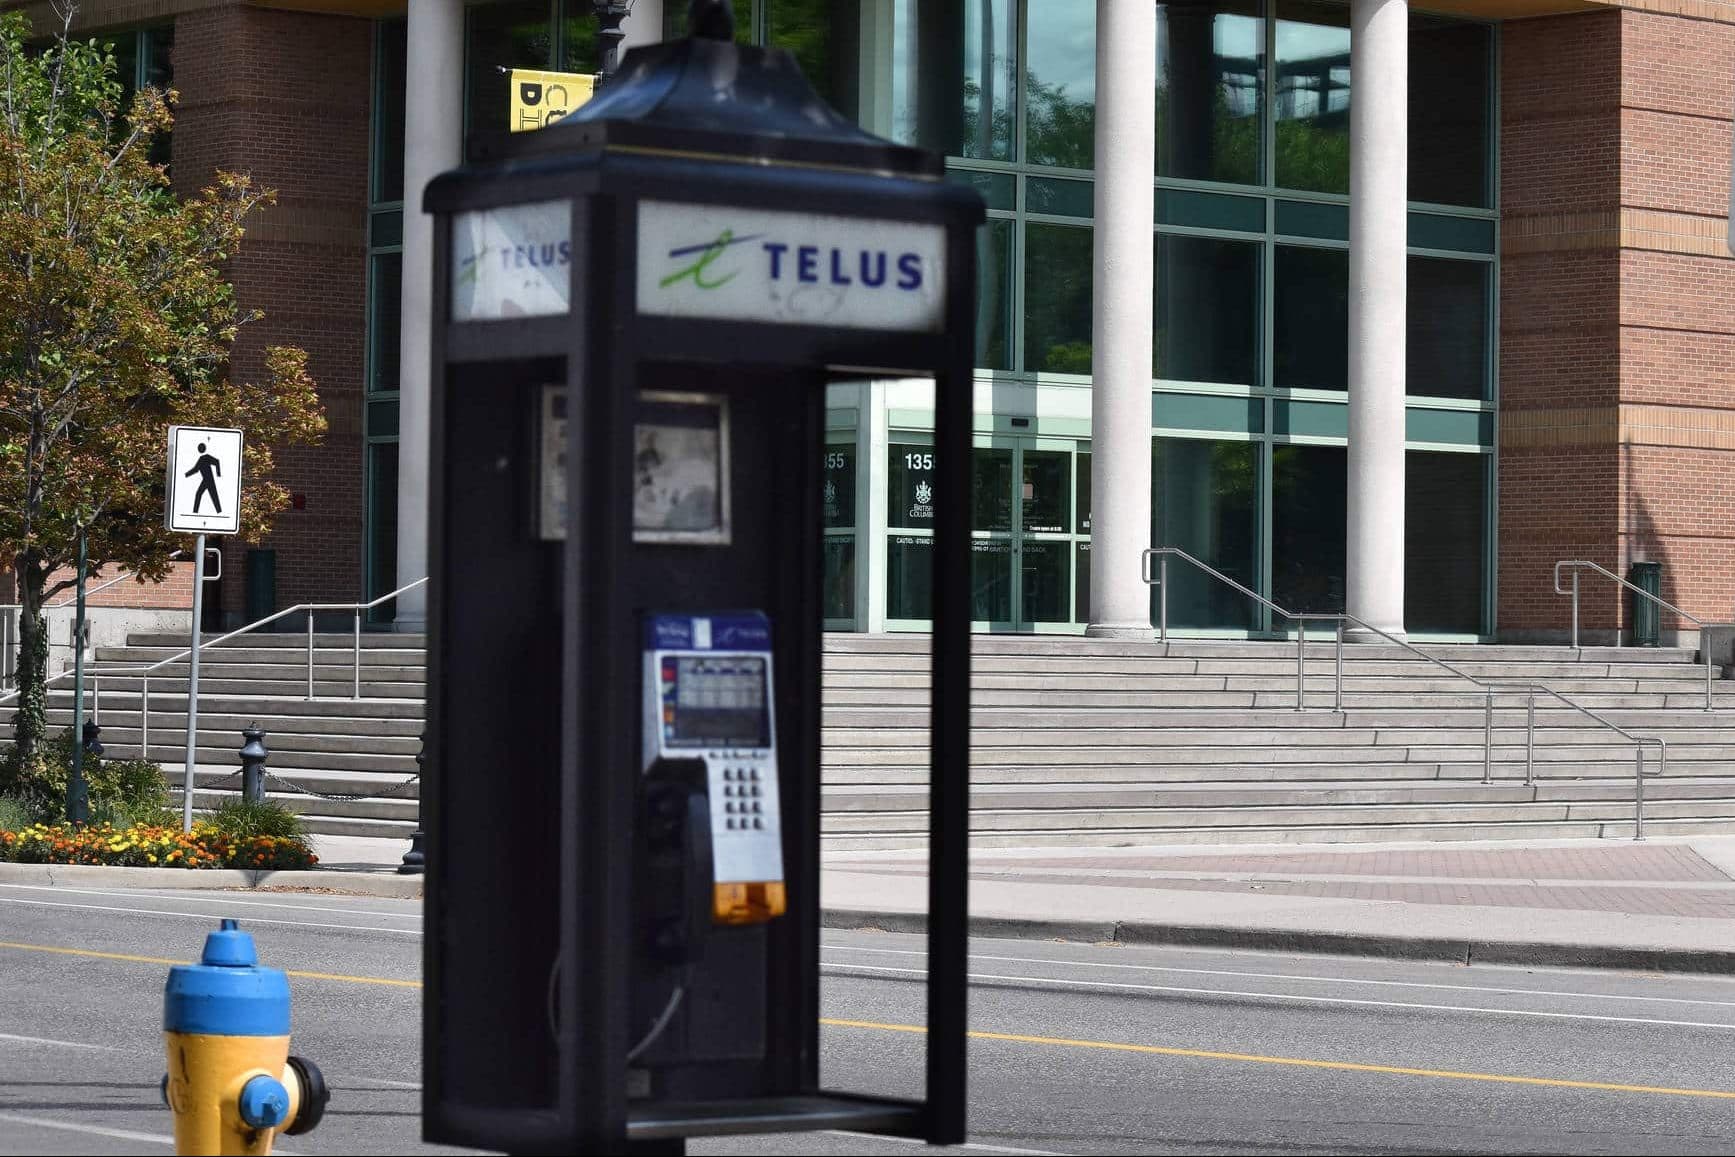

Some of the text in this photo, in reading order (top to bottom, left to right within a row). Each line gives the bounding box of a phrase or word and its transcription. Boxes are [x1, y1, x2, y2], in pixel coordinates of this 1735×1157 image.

[500, 240, 571, 272] TELUS
[763, 242, 924, 291] TELUS
[905, 453, 935, 470] 135
